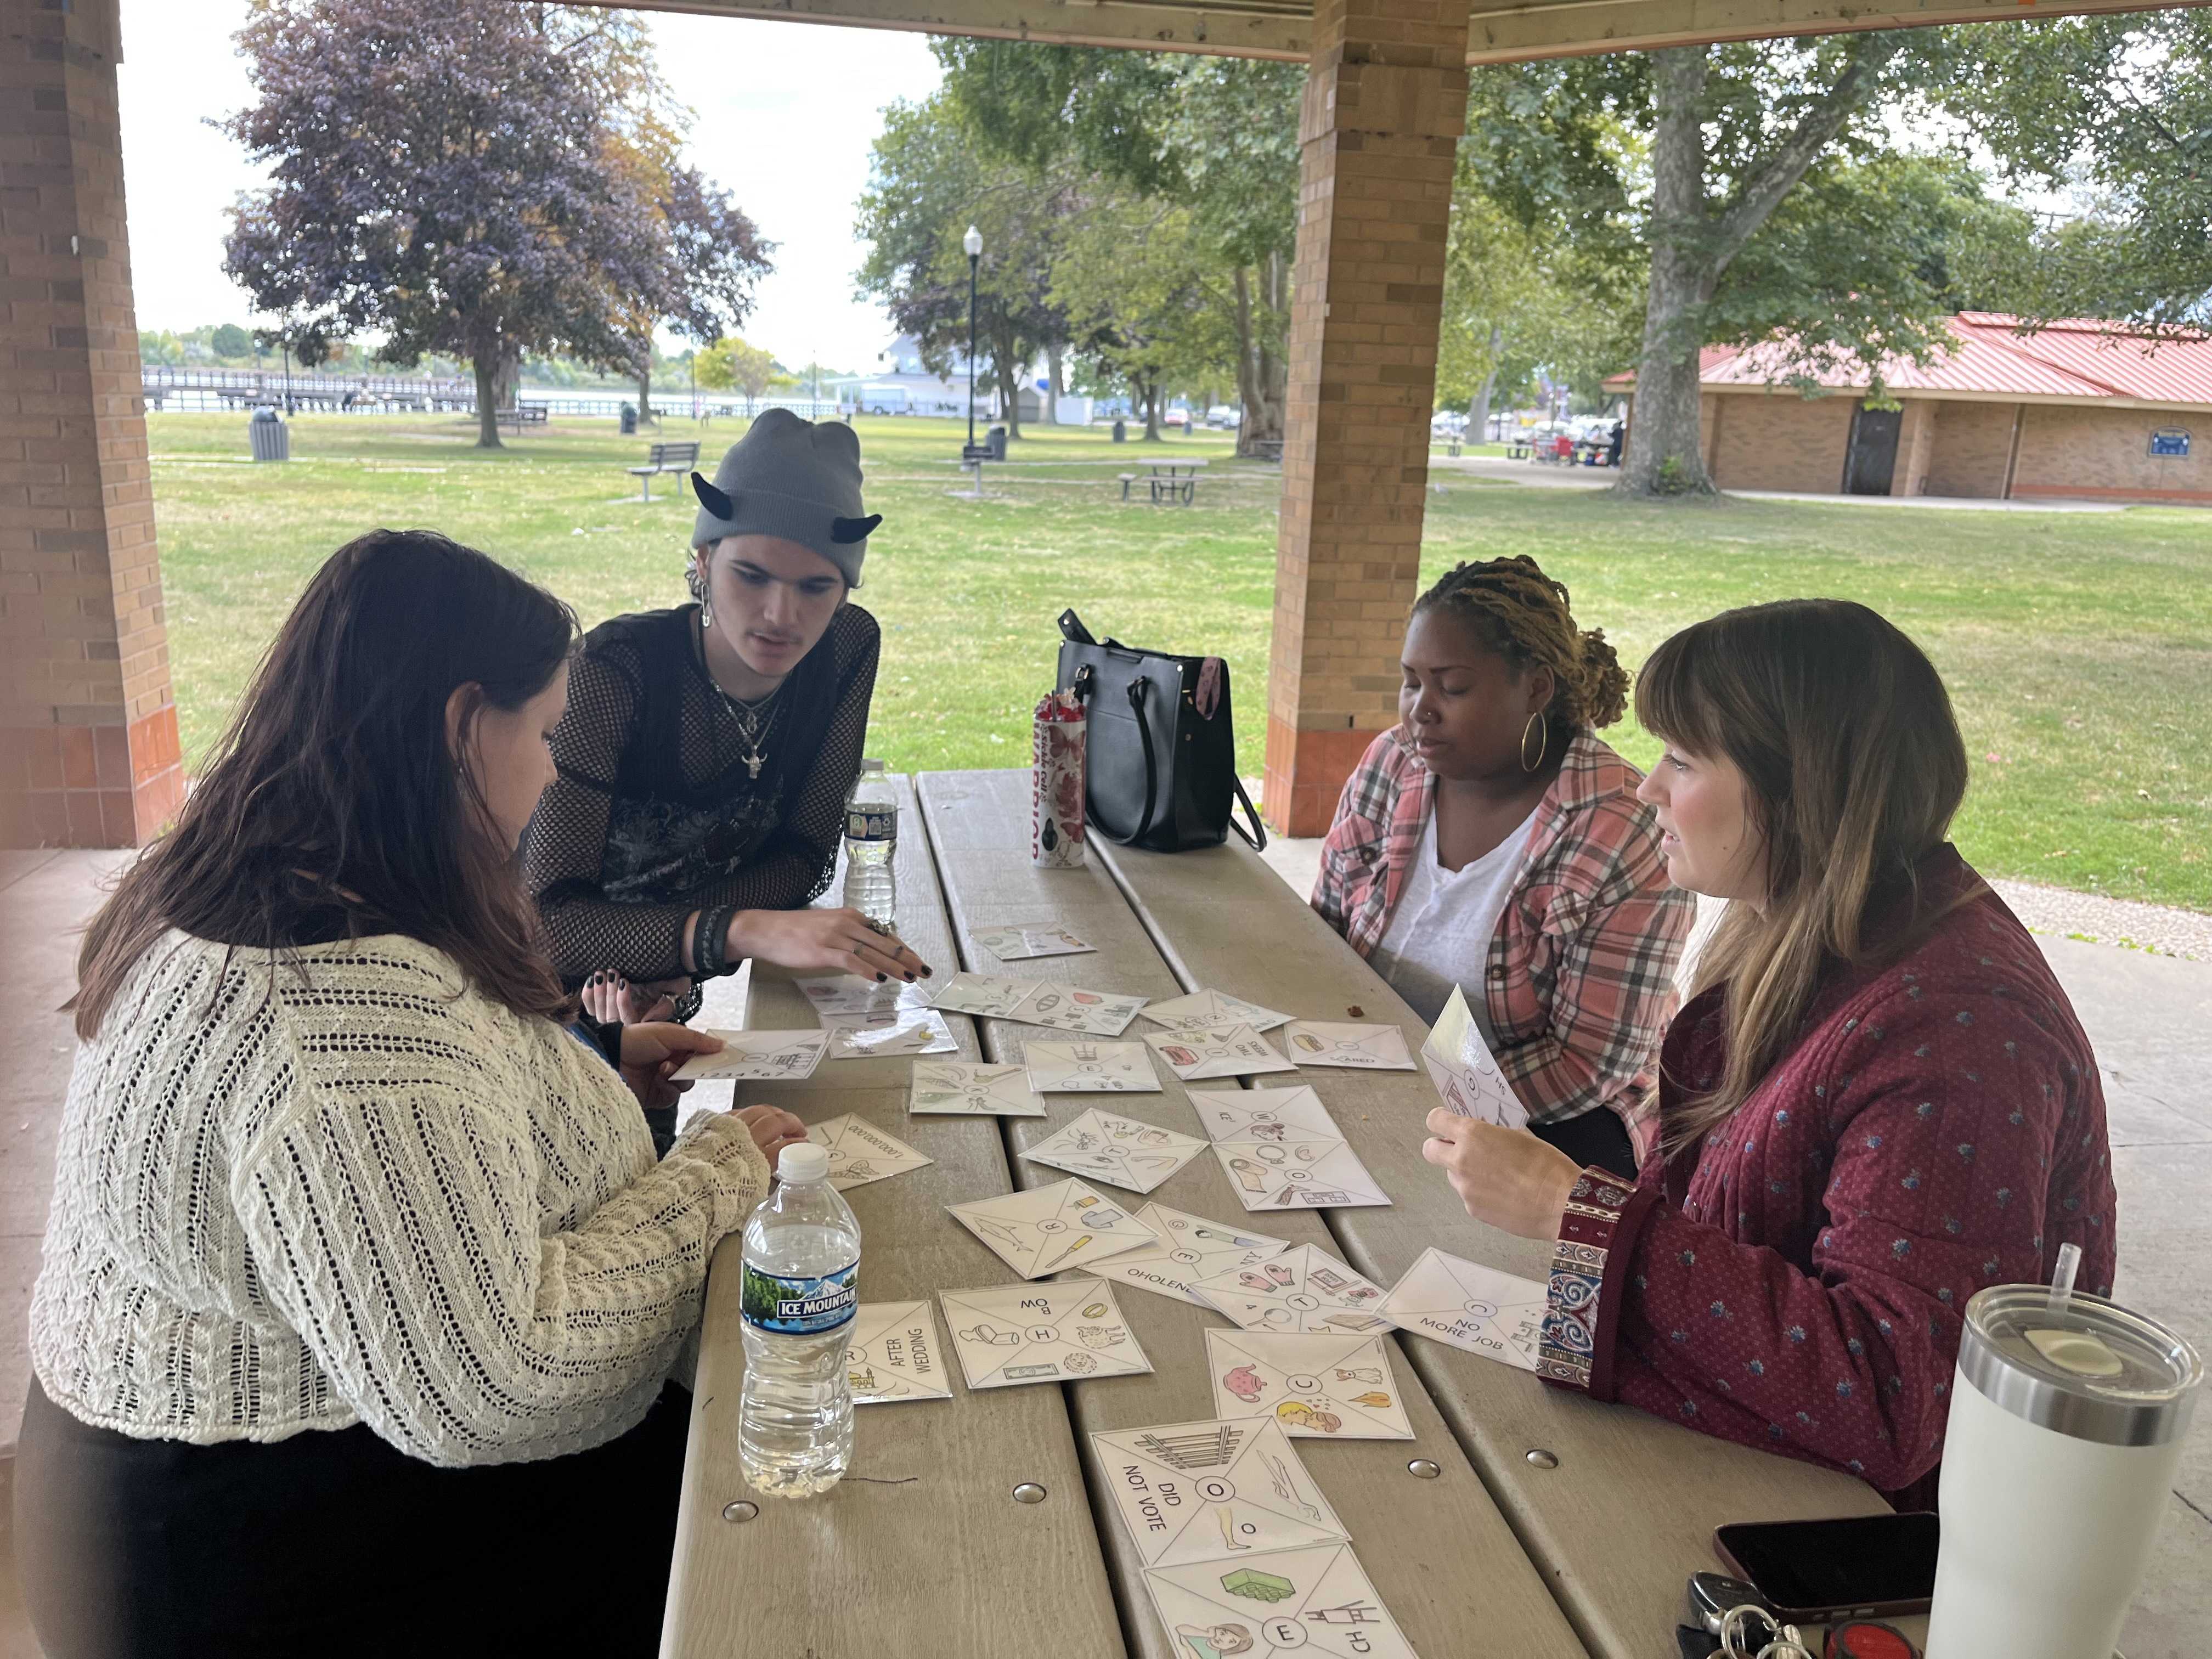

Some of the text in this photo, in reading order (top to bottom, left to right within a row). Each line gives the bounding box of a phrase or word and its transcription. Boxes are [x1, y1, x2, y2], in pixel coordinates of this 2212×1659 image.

[1235, 1045, 1252, 1057] TWO
[781, 1288, 856, 1315] ICE MOUNTAIN
[1420, 1318, 1504, 1350] MORE JOB
[1455, 1318, 1480, 1331] NO
[845, 1351, 855, 1361] R
[886, 1338, 906, 1367] AFTER
[908, 1328, 931, 1374] WEDDING
[1123, 1465, 1167, 1531] NOT VOTE
[1158, 1483, 1181, 1506] DID
[1276, 1624, 1294, 1640] E
